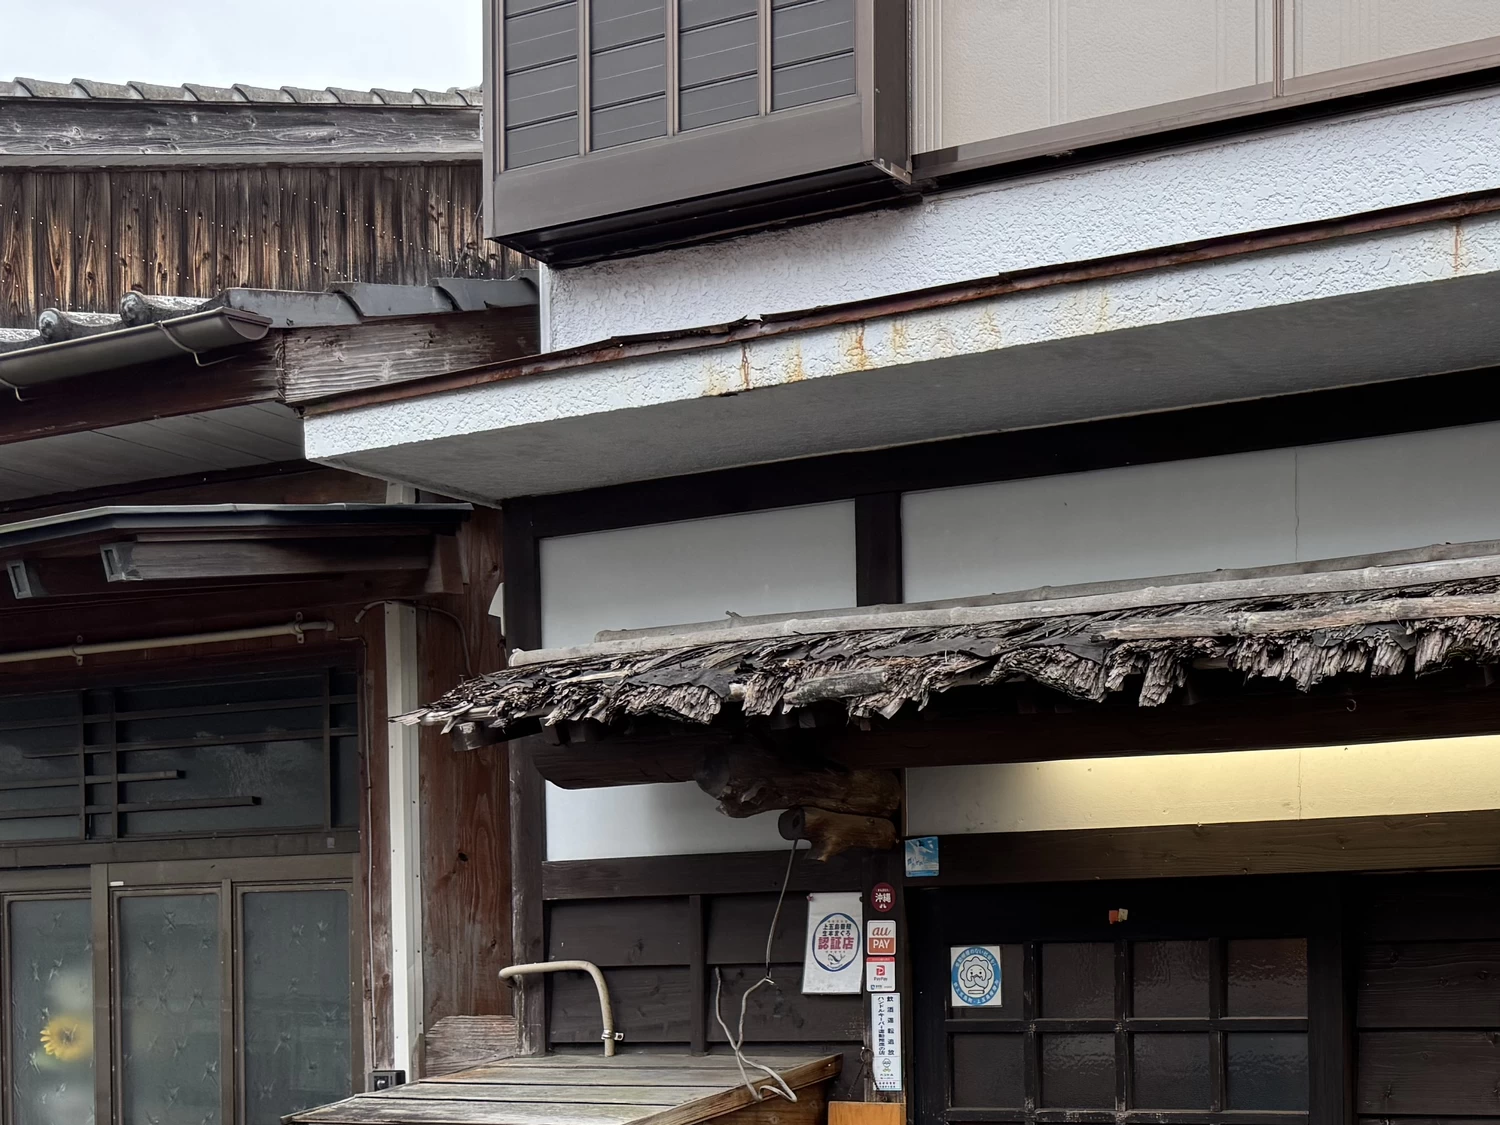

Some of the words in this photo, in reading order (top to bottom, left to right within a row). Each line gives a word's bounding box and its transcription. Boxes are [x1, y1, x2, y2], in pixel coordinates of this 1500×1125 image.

[872, 927, 891, 937] au
[817, 936, 854, 950] 認証店
[872, 939, 890, 949] PAY
[886, 996, 895, 1056] 飲酒運転追放
